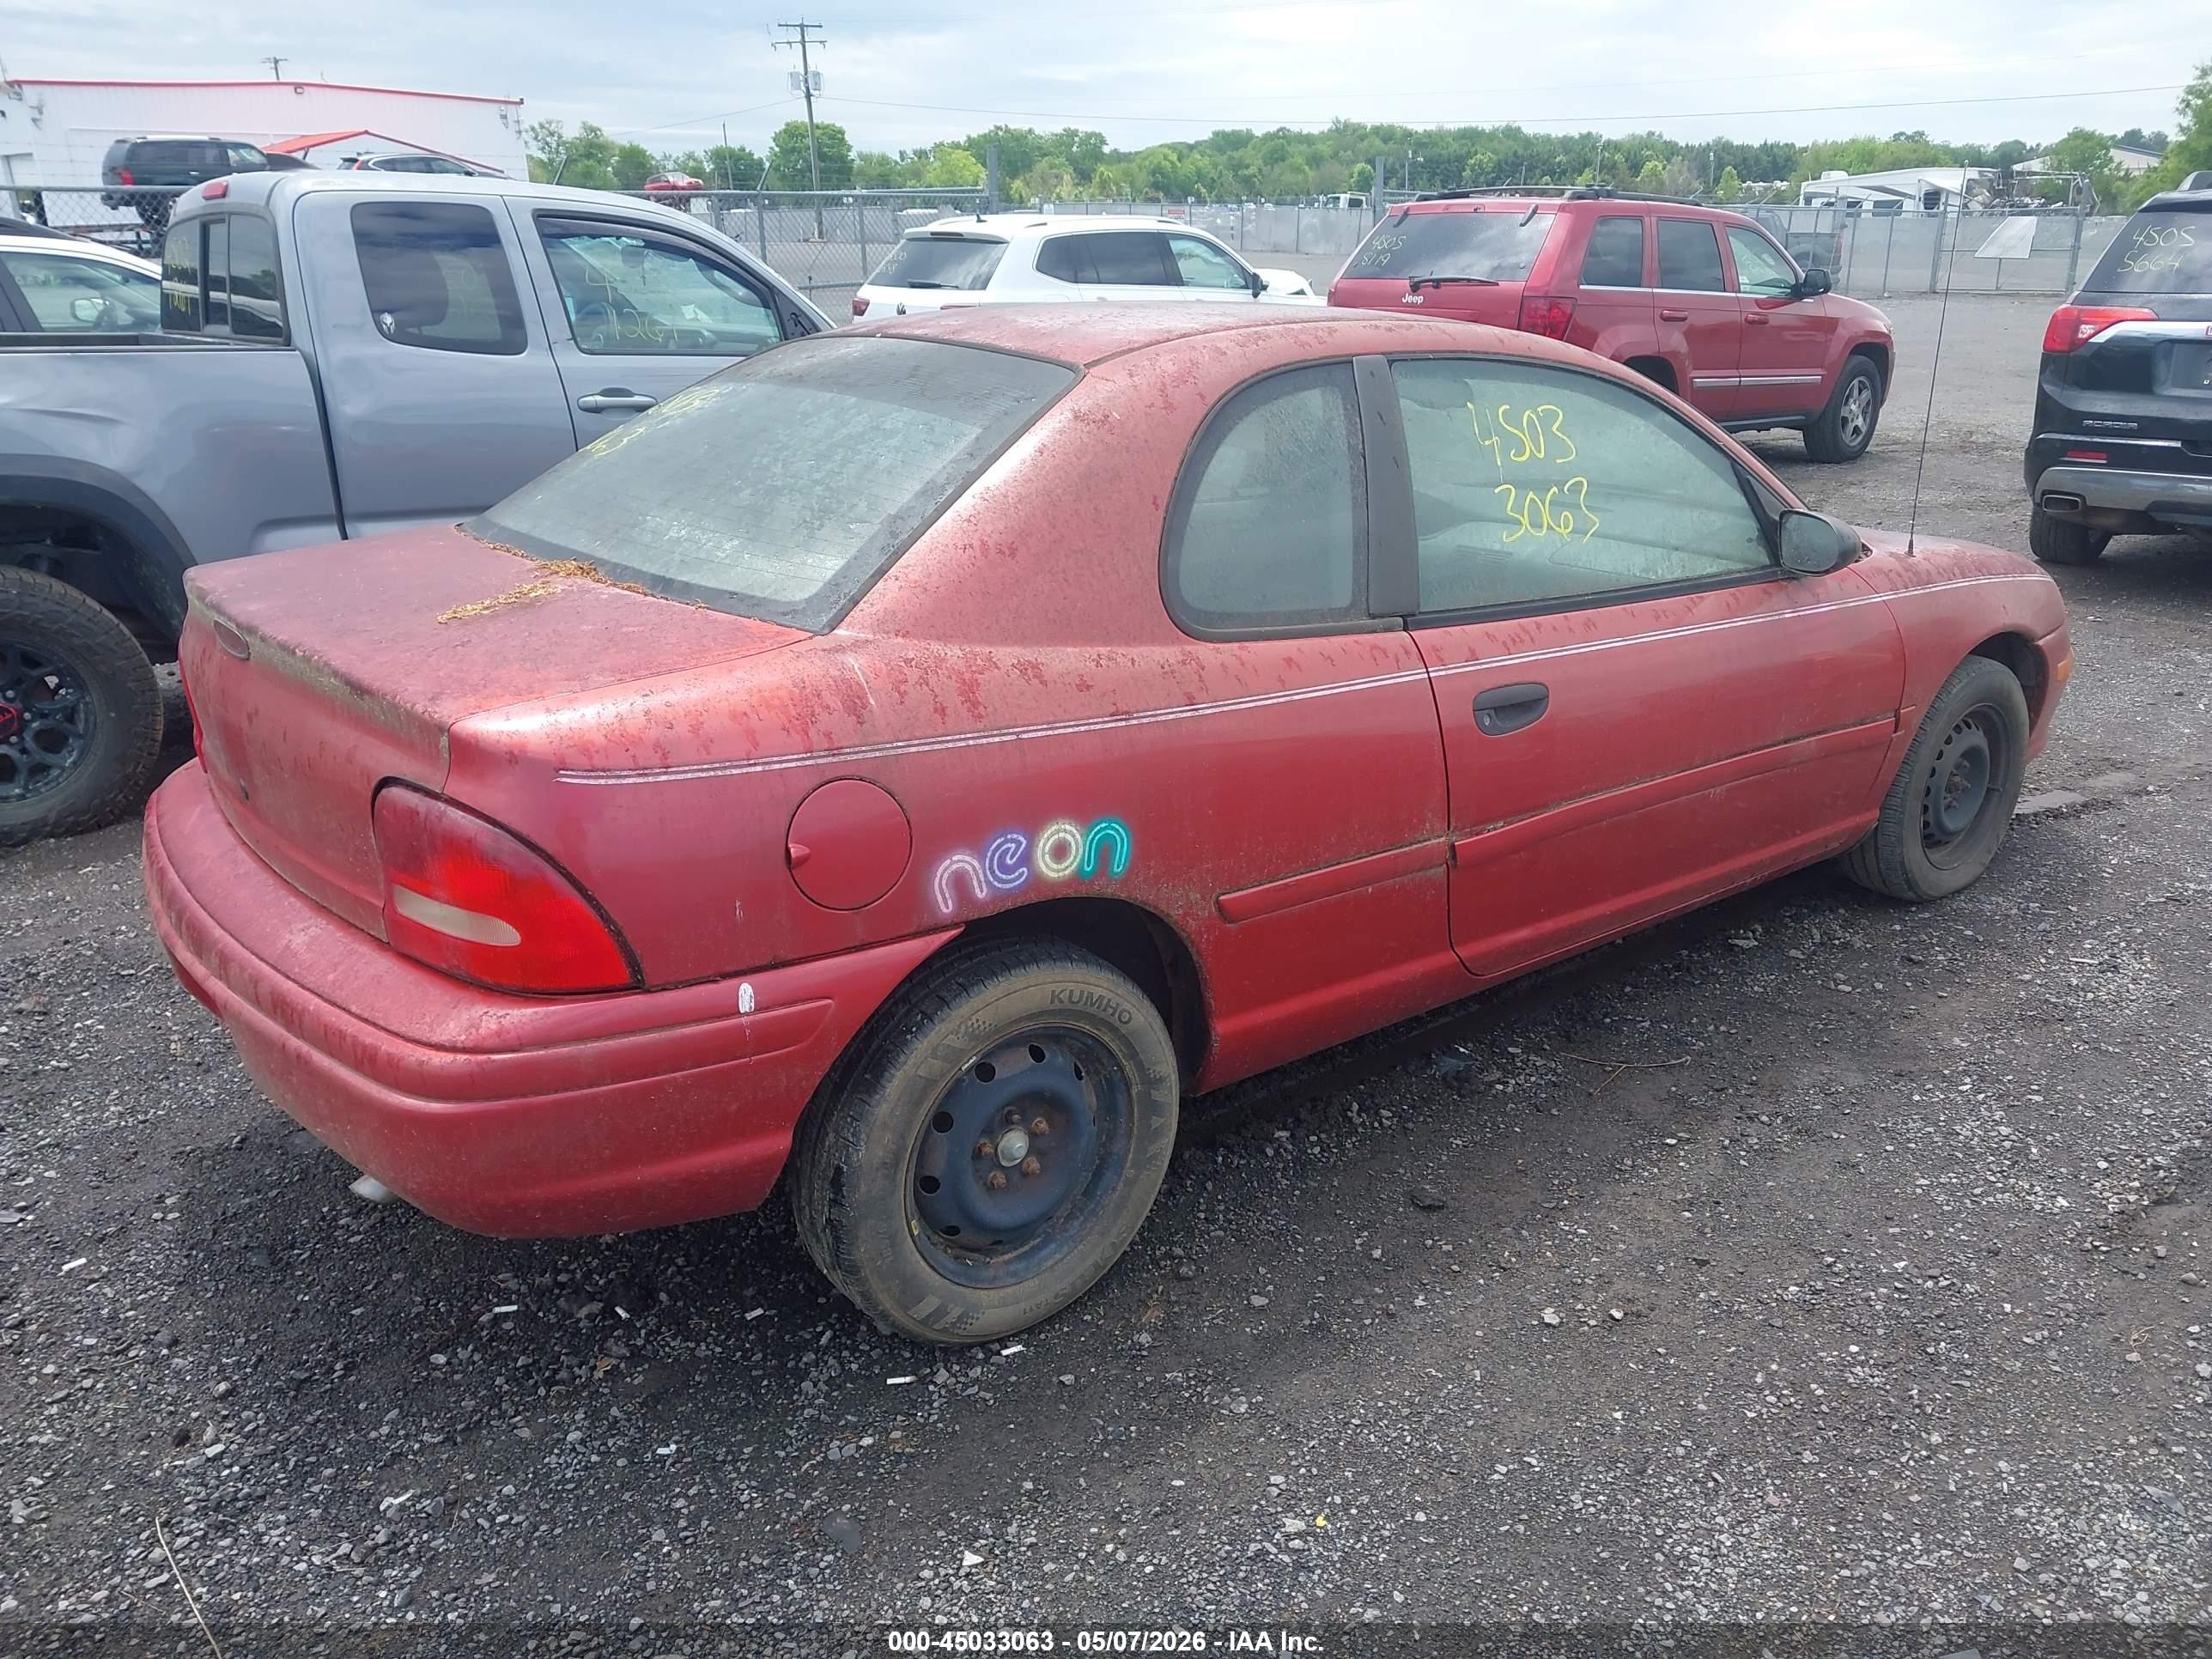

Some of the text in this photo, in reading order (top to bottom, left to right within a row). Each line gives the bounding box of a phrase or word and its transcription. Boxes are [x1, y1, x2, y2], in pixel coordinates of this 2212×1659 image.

[2132, 224, 2196, 249] 4505
[2116, 250, 2184, 274] 5664
[1401, 293, 1424, 305] Jeep
[2082, 420, 2138, 429] ACADIA
[1467, 401, 1576, 483] 4503
[1494, 477, 1600, 544] 3063
[933, 822, 1128, 915] neon
[1049, 988, 1133, 1025] KUMHO
